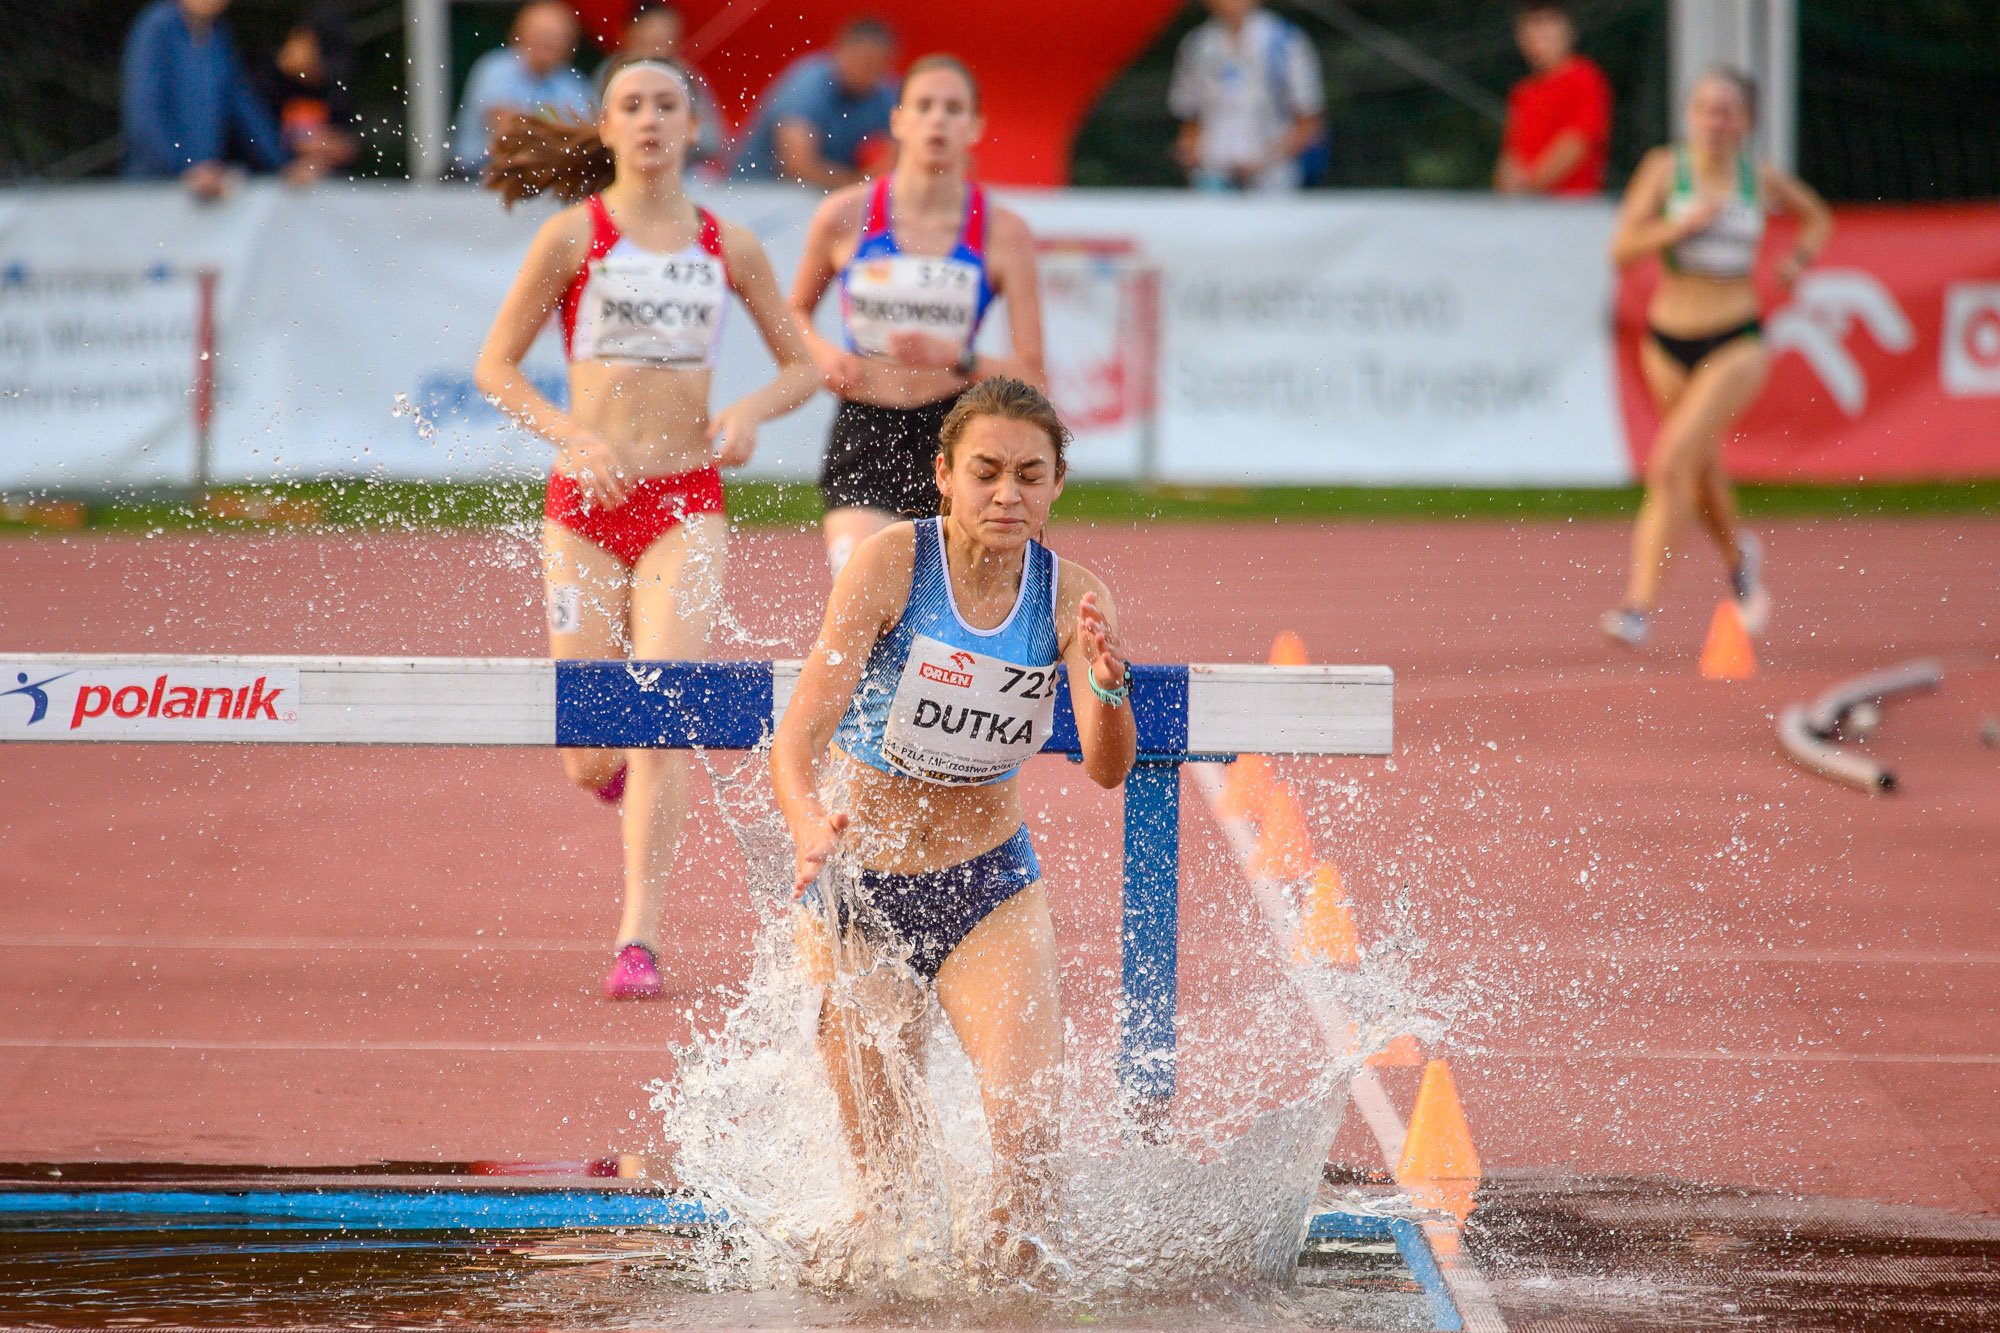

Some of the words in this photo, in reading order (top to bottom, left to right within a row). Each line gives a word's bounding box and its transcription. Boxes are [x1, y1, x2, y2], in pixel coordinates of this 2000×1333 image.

[602, 299, 712, 328] PROCYK
[922, 665, 970, 687] ORLEN
[70, 674, 285, 731] polanik
[913, 697, 1033, 746] DUTKA
